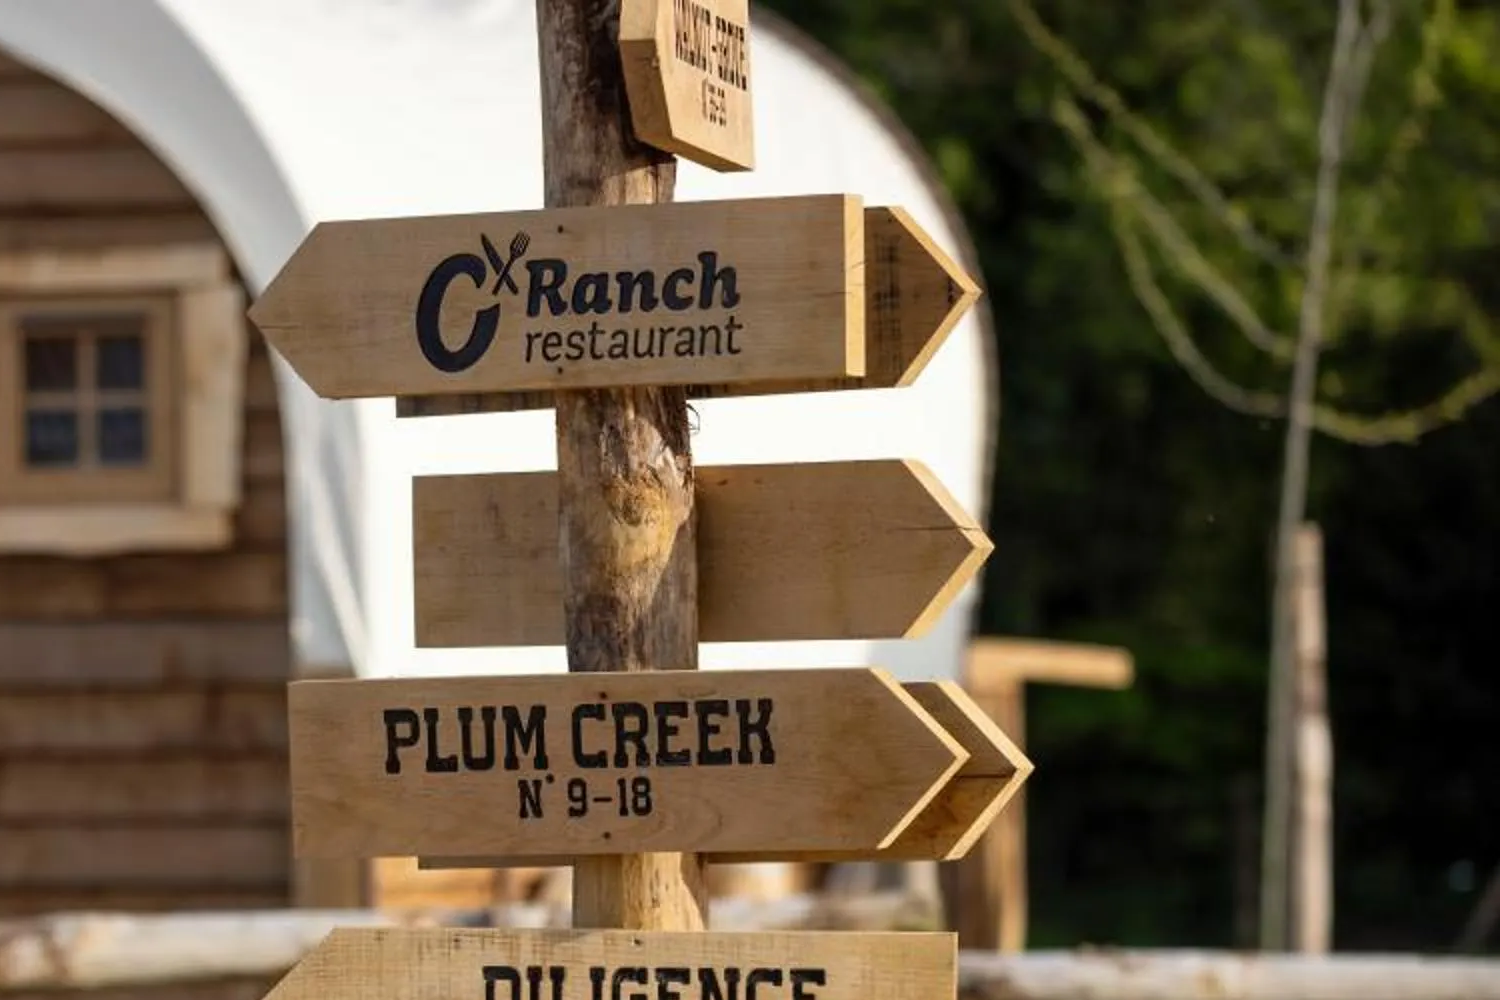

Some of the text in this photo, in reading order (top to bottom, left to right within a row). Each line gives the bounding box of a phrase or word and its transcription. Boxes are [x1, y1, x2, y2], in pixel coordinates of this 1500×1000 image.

[524, 250, 742, 318] Ranch
[525, 315, 744, 364] restaurant
[383, 697, 776, 775] PLUM CREEK
[567, 775, 653, 819] 9-18
